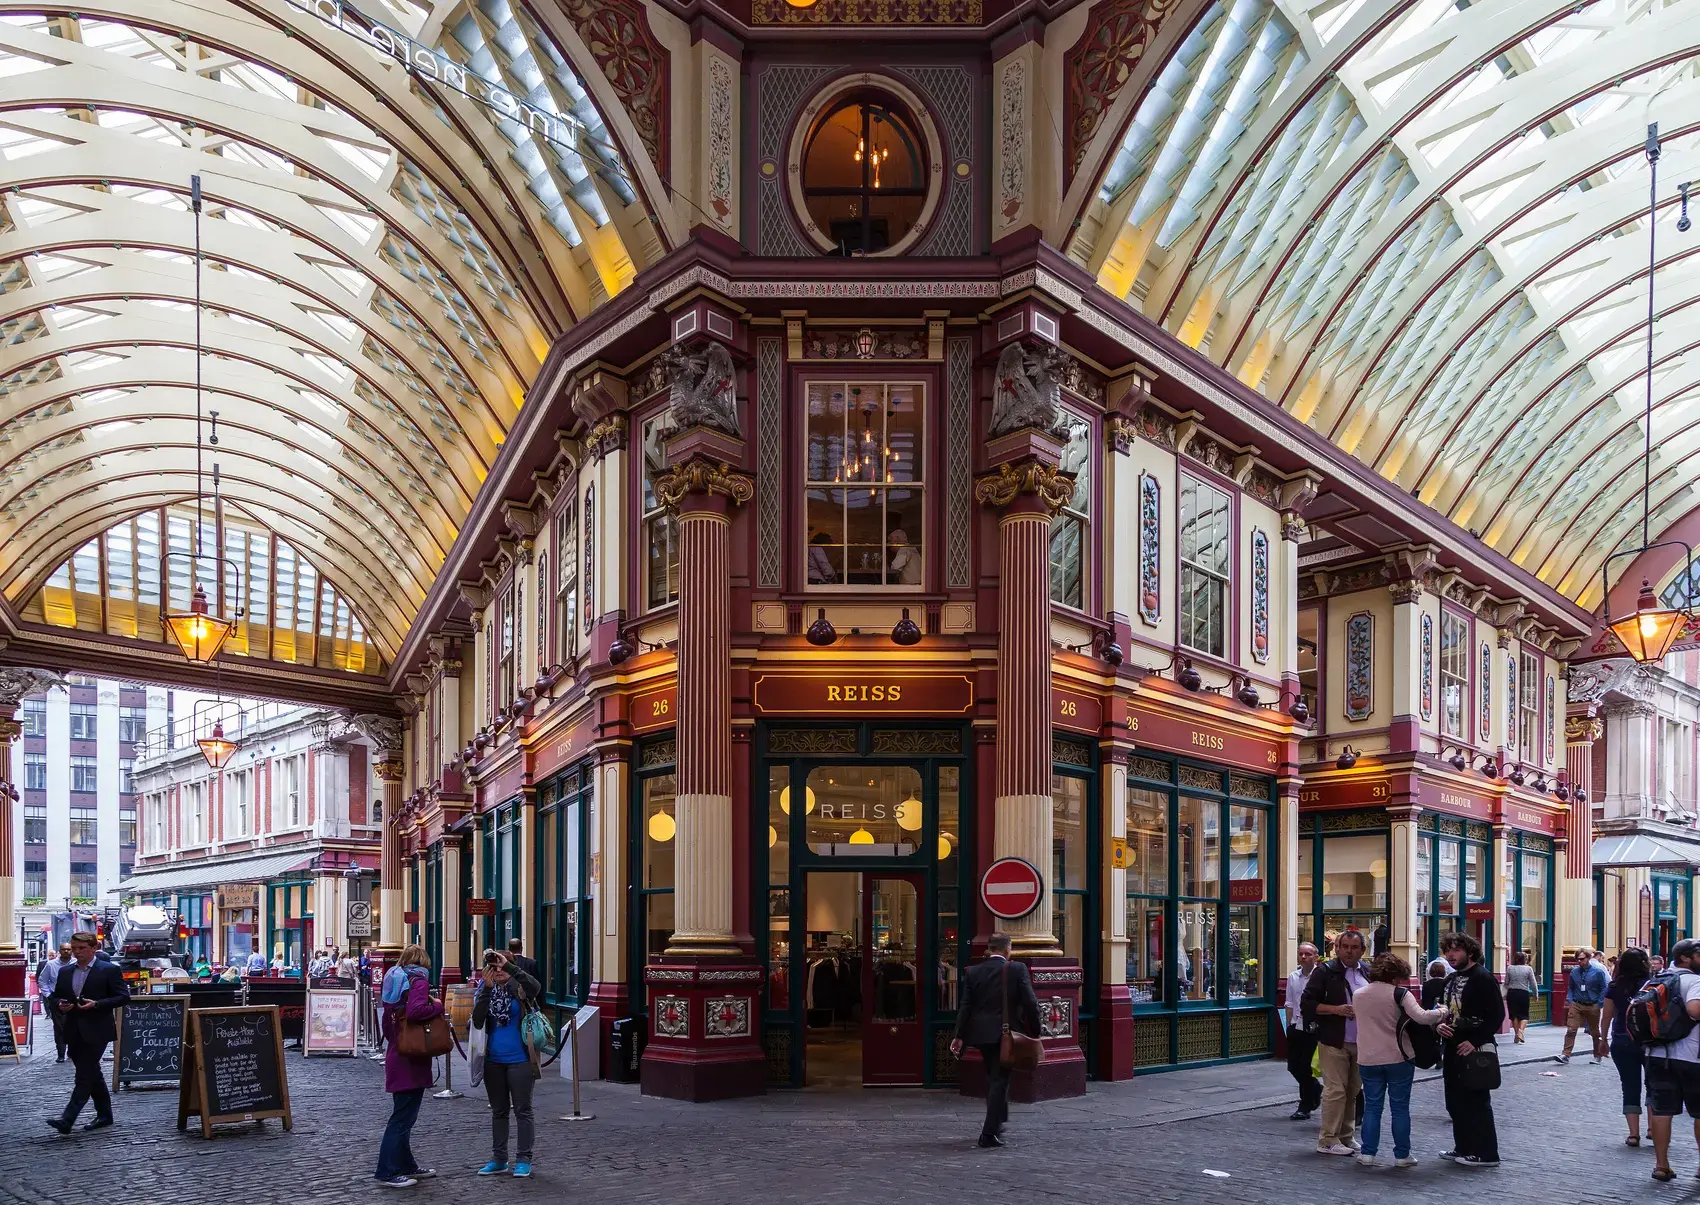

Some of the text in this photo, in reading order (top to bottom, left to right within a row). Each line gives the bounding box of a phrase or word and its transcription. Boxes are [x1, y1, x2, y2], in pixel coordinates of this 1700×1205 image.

[827, 685, 902, 702] REISS
[652, 699, 669, 716] 26
[1060, 699, 1077, 717] 26
[1126, 716, 1139, 731] 26
[556, 738, 572, 758] REISS
[1191, 731, 1225, 750] REISS
[1267, 750, 1277, 764] 26
[1299, 786, 1387, 802] UR 31
[1440, 792, 1472, 809] BARBOUR
[821, 803, 905, 819] REISS
[1517, 811, 1542, 826] BARBOUR
[1232, 886, 1260, 897] REISS
[1178, 911, 1214, 925] REISS
[151, 1012, 172, 1020] MAIN
[133, 1028, 158, 1039] ICE
[142, 1036, 180, 1049] LOLLIES!
[630, 1031, 639, 1070] squaremile
